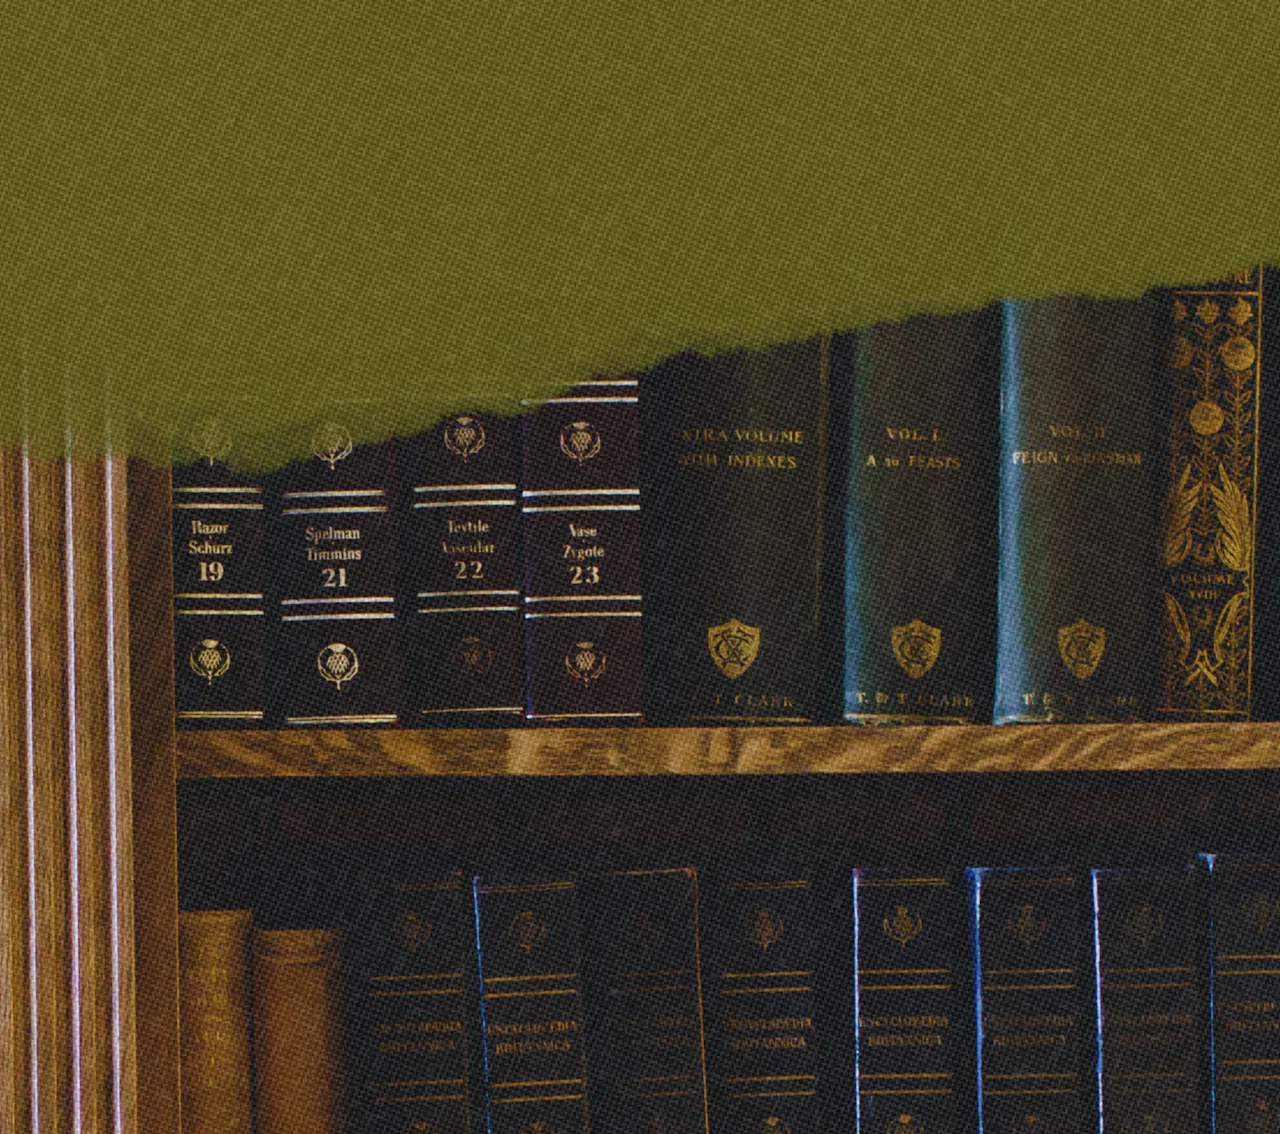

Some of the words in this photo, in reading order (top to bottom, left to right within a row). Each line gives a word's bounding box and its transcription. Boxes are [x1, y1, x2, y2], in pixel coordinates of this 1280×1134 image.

[672, 429, 728, 442] XTRA
[735, 430, 804, 444] VOLUME
[728, 455, 797, 468] INDEXES
[192, 520, 229, 536] Razor
[305, 527, 361, 544] Spelman
[188, 540, 233, 555] Schurz
[306, 547, 362, 561] Timmins
[562, 544, 605, 561] Zygote
[198, 561, 224, 582] 19
[321, 568, 349, 588] 21
[454, 561, 485, 580] 22
[569, 566, 601, 585] 23
